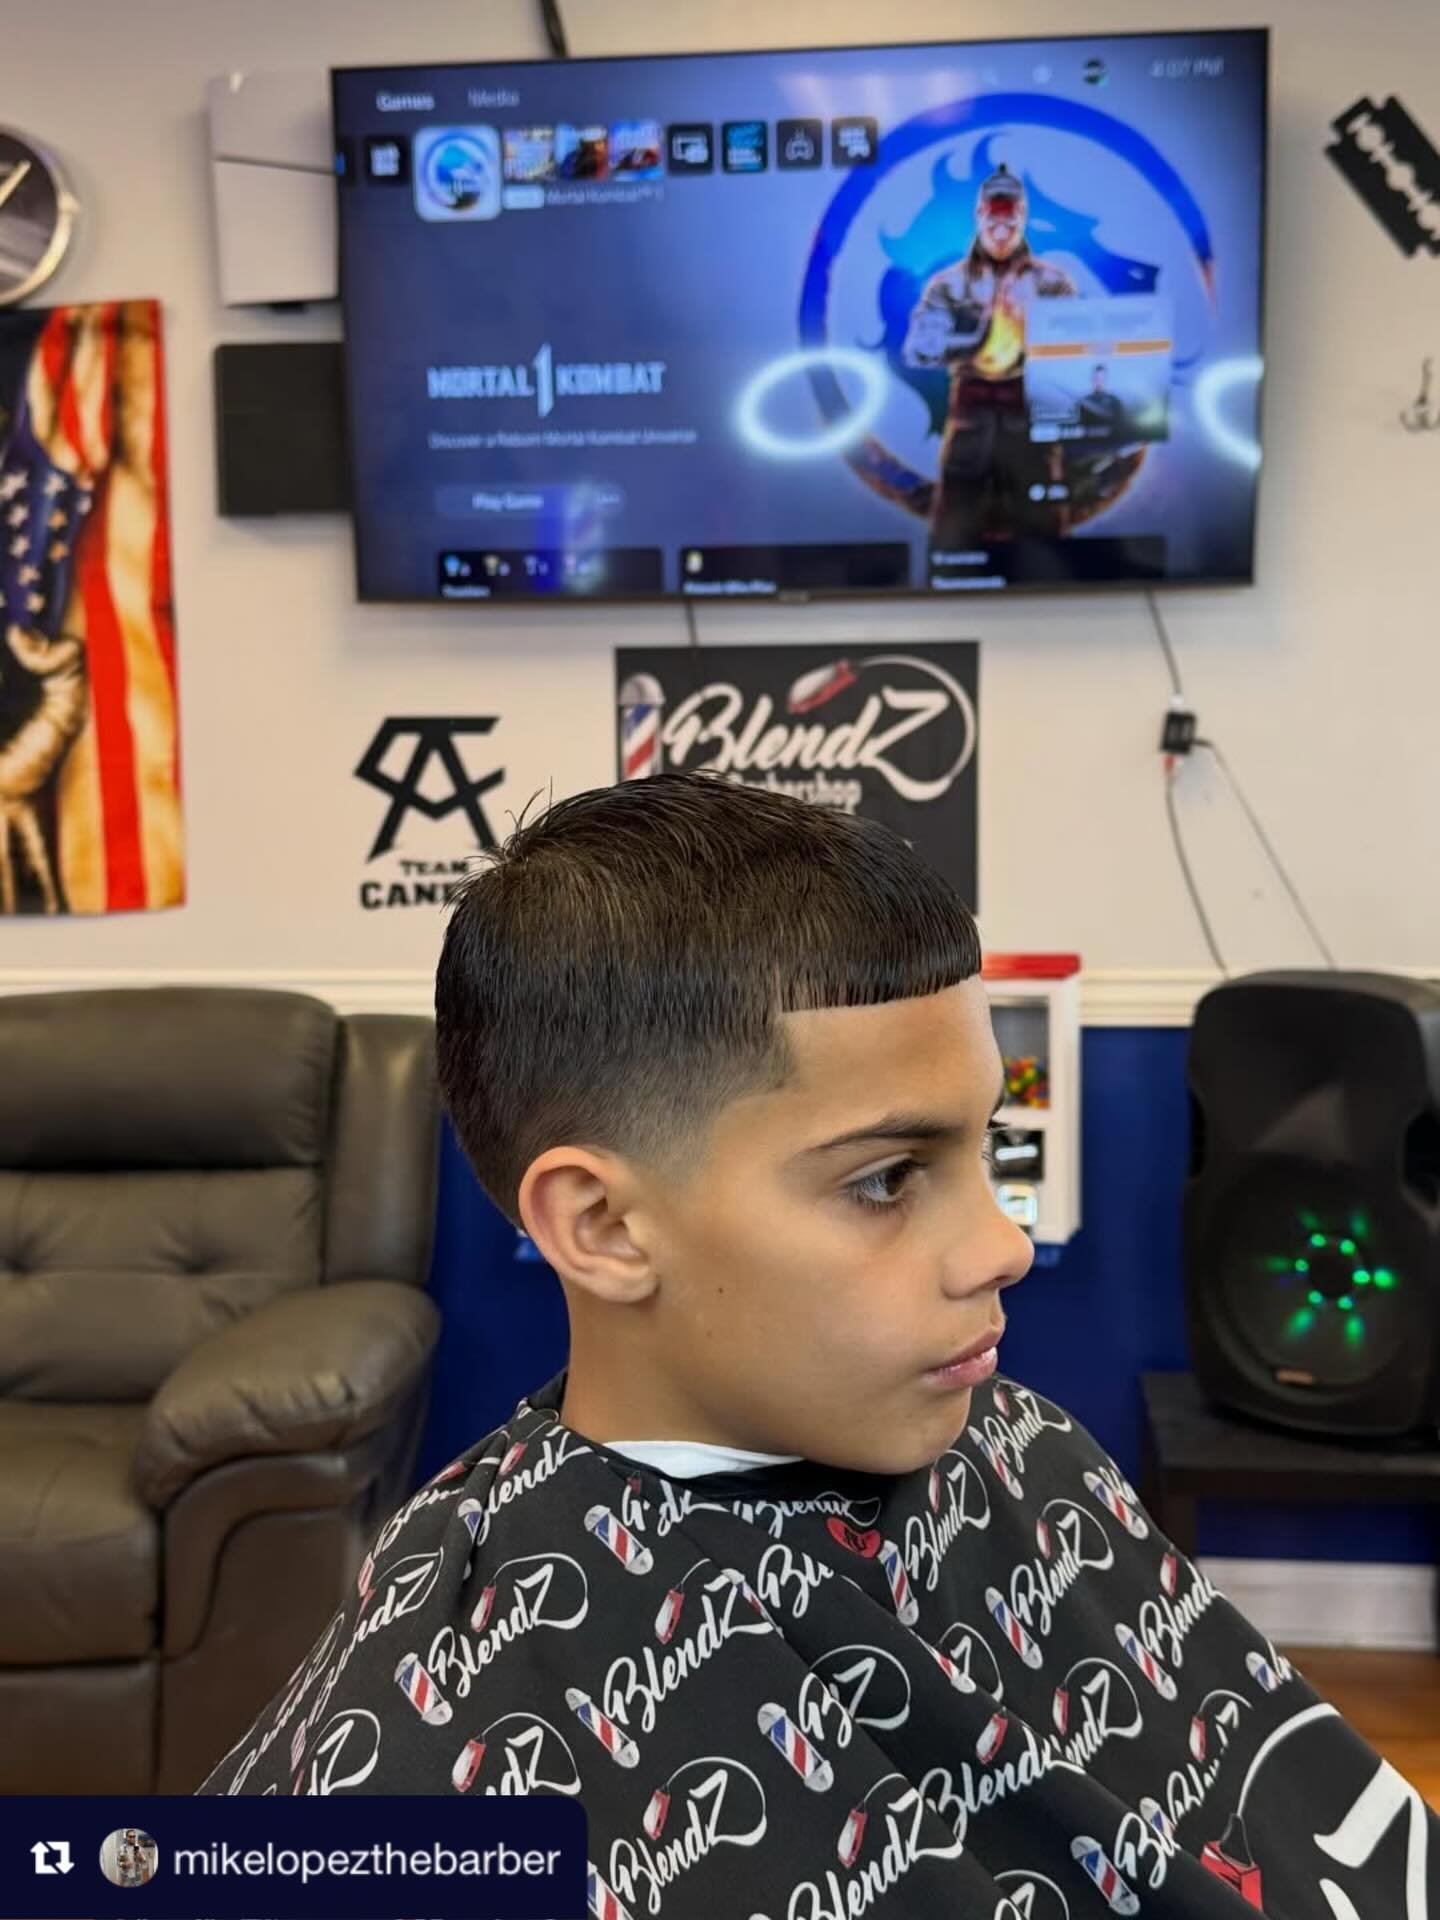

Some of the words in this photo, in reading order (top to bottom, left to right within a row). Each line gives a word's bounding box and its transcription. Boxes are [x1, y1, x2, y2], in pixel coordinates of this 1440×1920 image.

[427, 365, 534, 398] MORTAL
[555, 361, 666, 395] KOMBAT
[400, 860, 469, 876] TEAM
